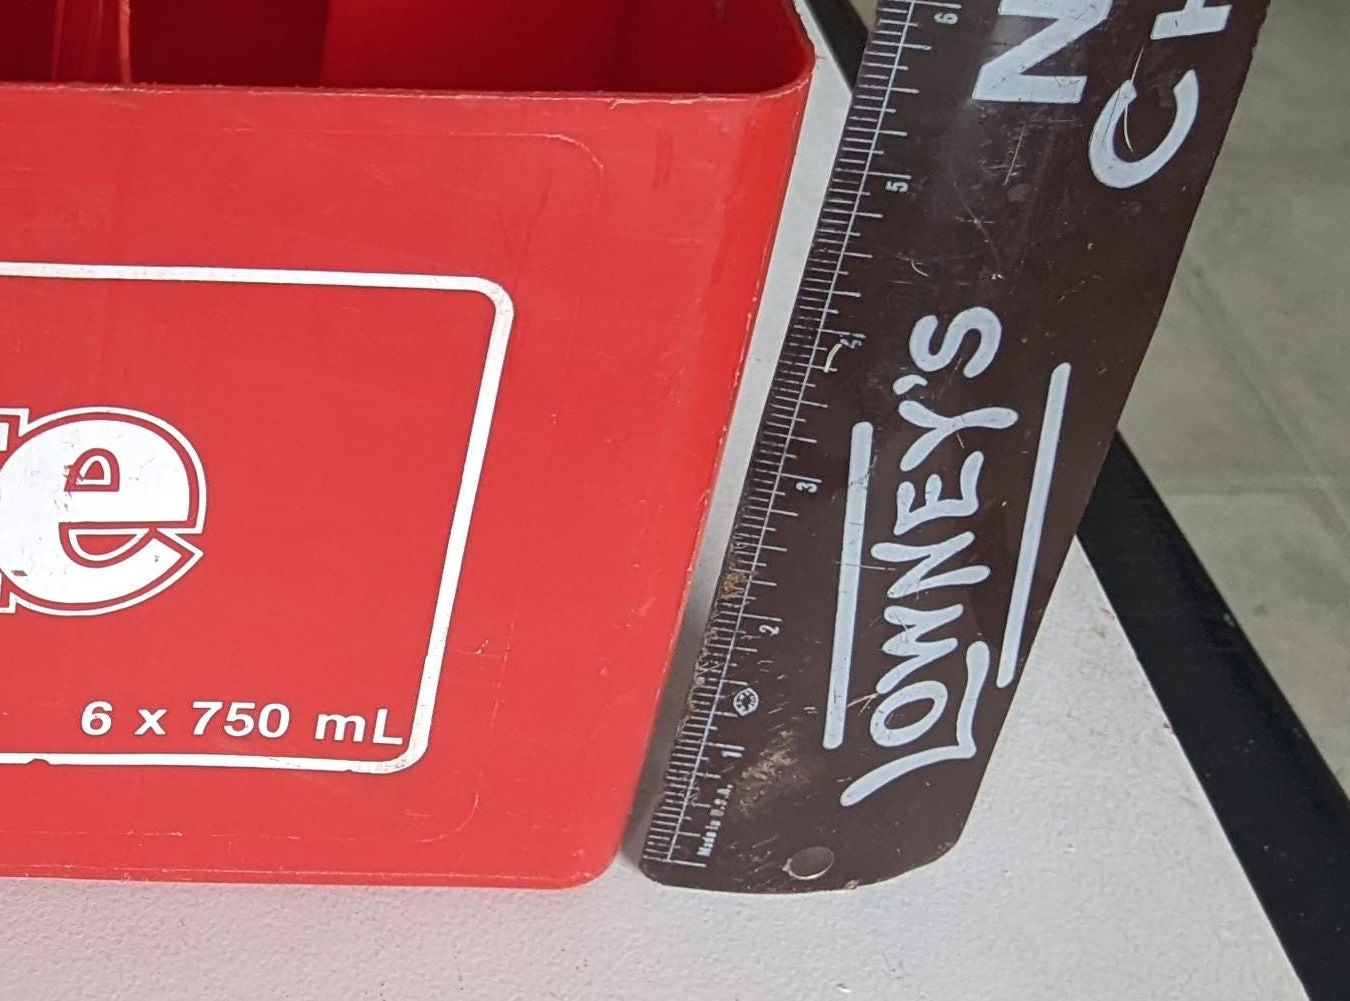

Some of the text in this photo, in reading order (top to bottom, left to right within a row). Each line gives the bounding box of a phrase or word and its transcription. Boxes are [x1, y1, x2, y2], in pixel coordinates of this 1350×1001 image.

[934, 11, 959, 26] 6
[885, 180, 909, 193] 5
[795, 480, 818, 494] 3
[839, 304, 1020, 808] LOWNEY'S
[759, 623, 780, 637] 2
[80, 700, 404, 745] 6 x 750 mL
[721, 749, 743, 759] 1
[696, 830, 719, 857] Made
[709, 783, 734, 817] U.S.A.
